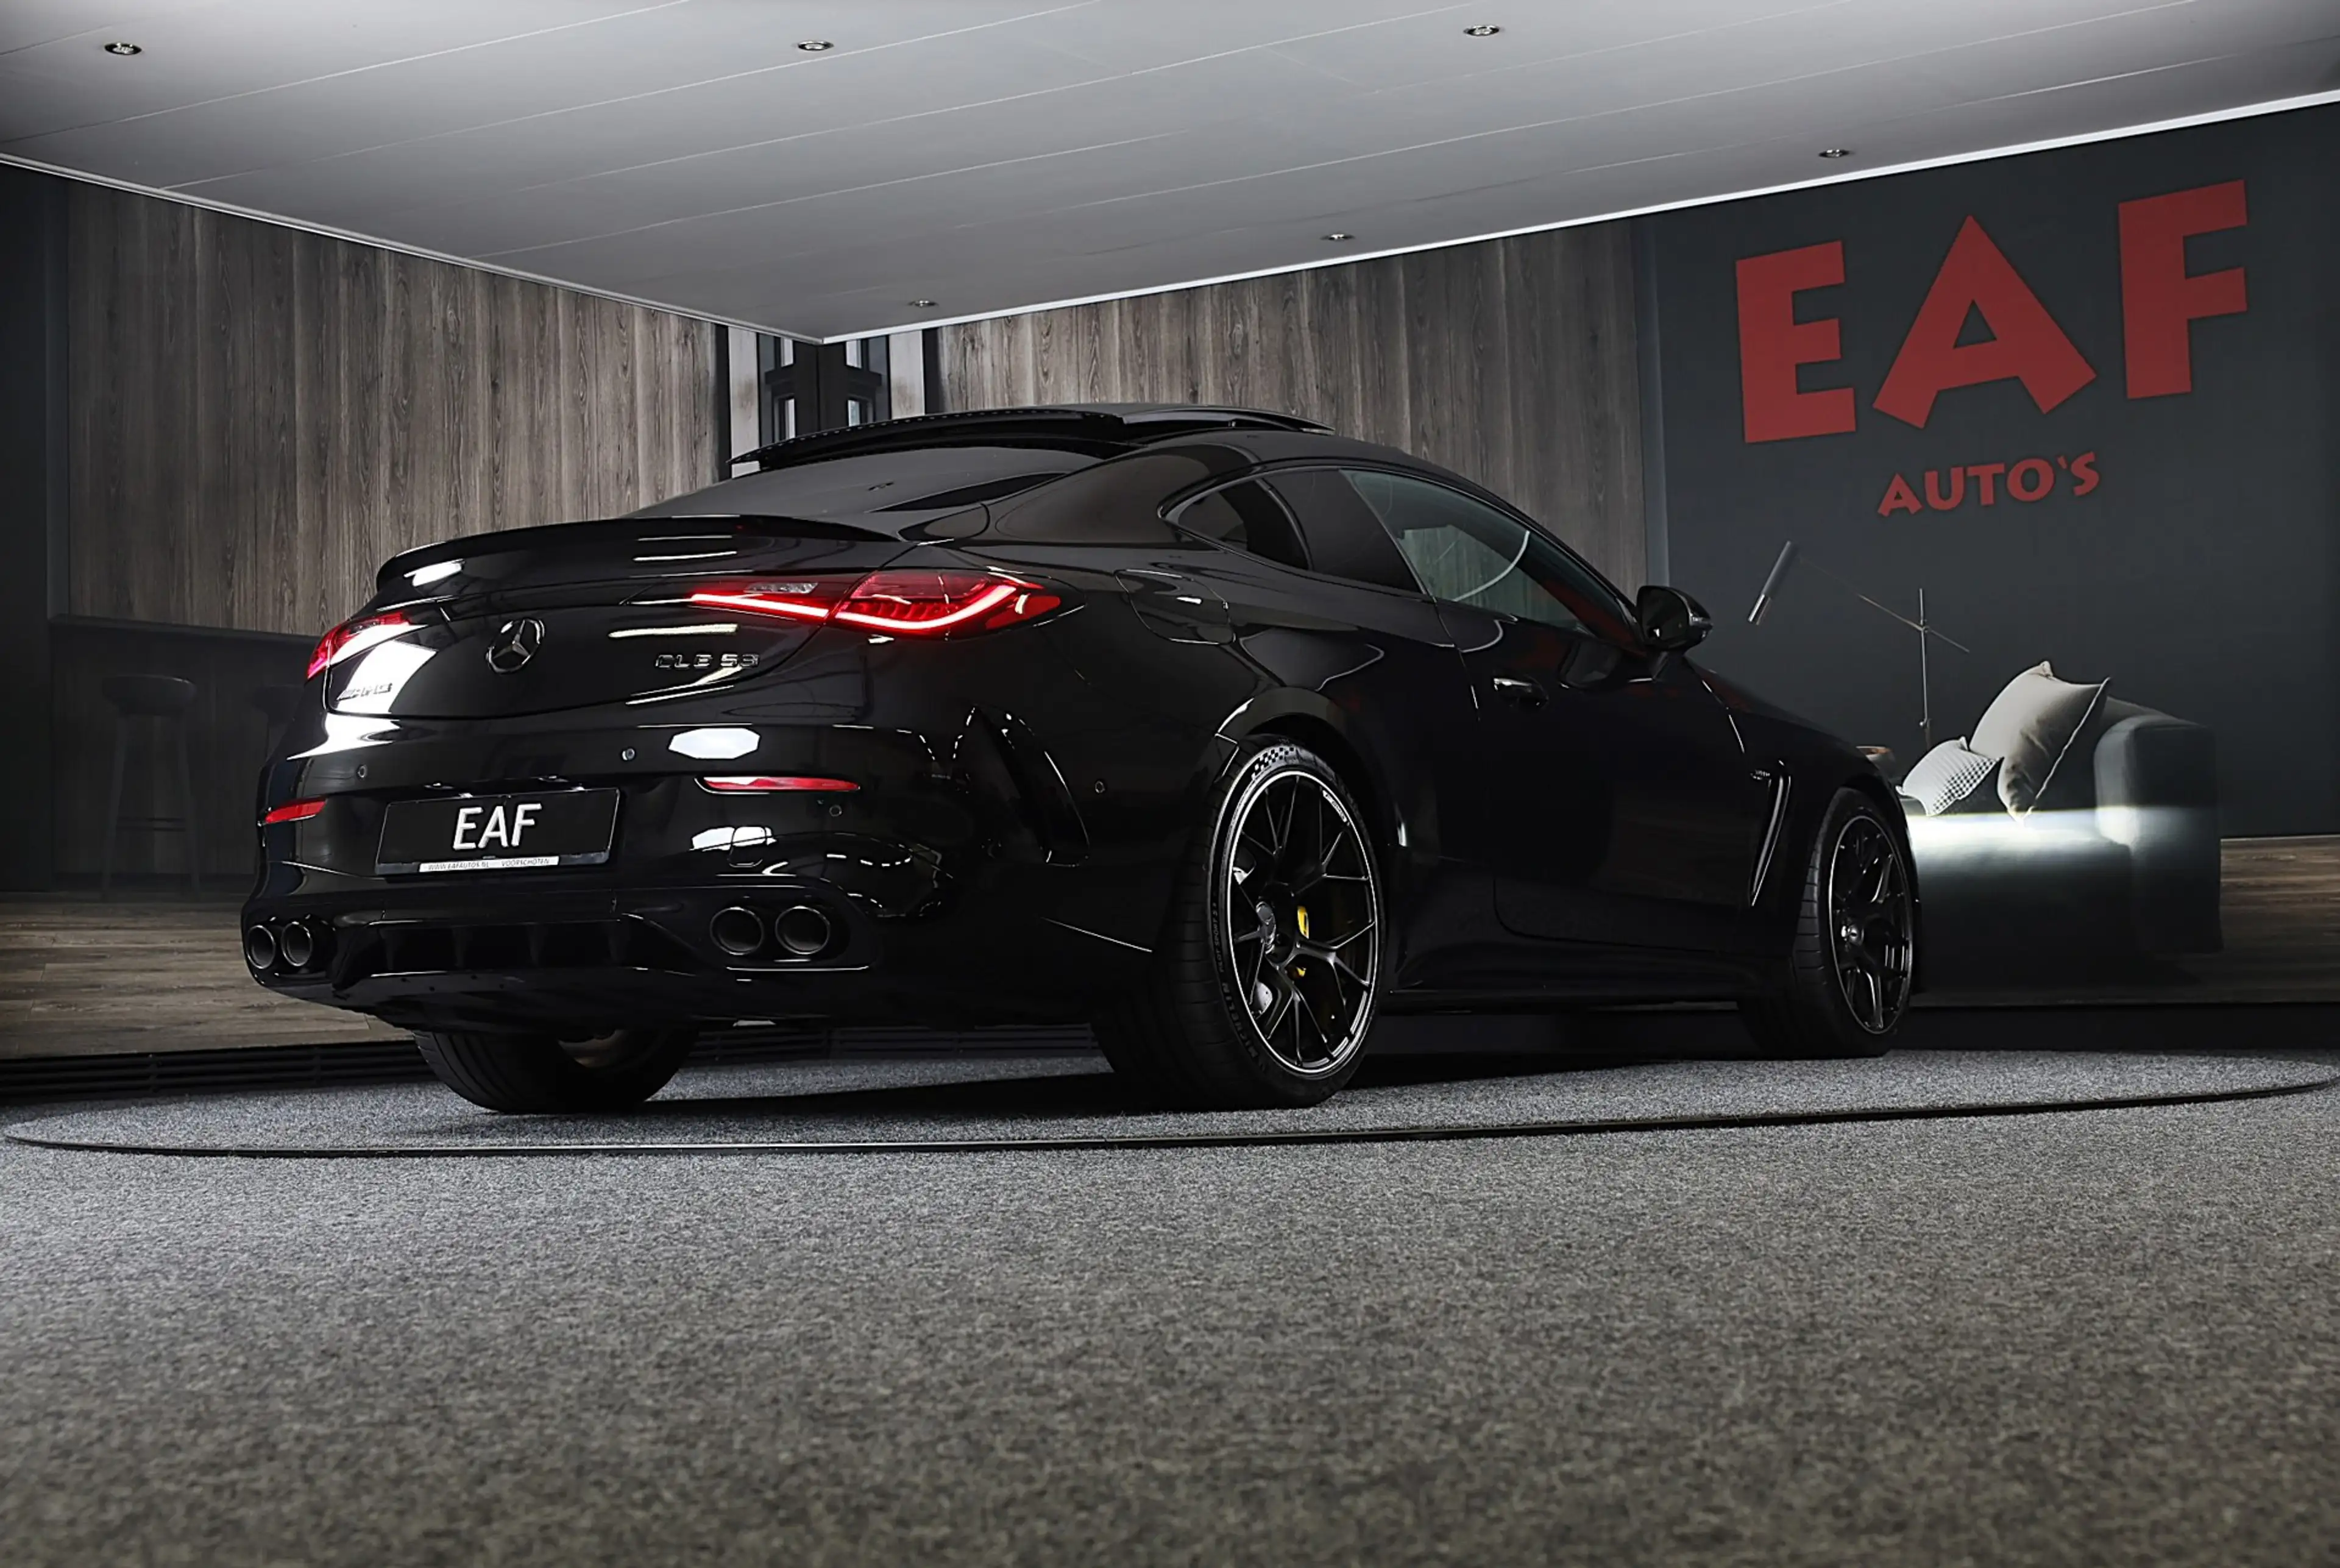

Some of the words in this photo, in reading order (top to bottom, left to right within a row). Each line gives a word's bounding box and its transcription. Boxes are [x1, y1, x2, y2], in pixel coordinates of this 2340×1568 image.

[1736, 179, 2248, 442] EAF
[1877, 452, 2100, 517] AUTO'S
[655, 654, 713, 669] CLE
[720, 653, 760, 667] 53
[453, 803, 542, 851] EAF
[502, 858, 550, 867] VOORSCHOTEN
[1222, 982, 1258, 1058] MICHELIN
